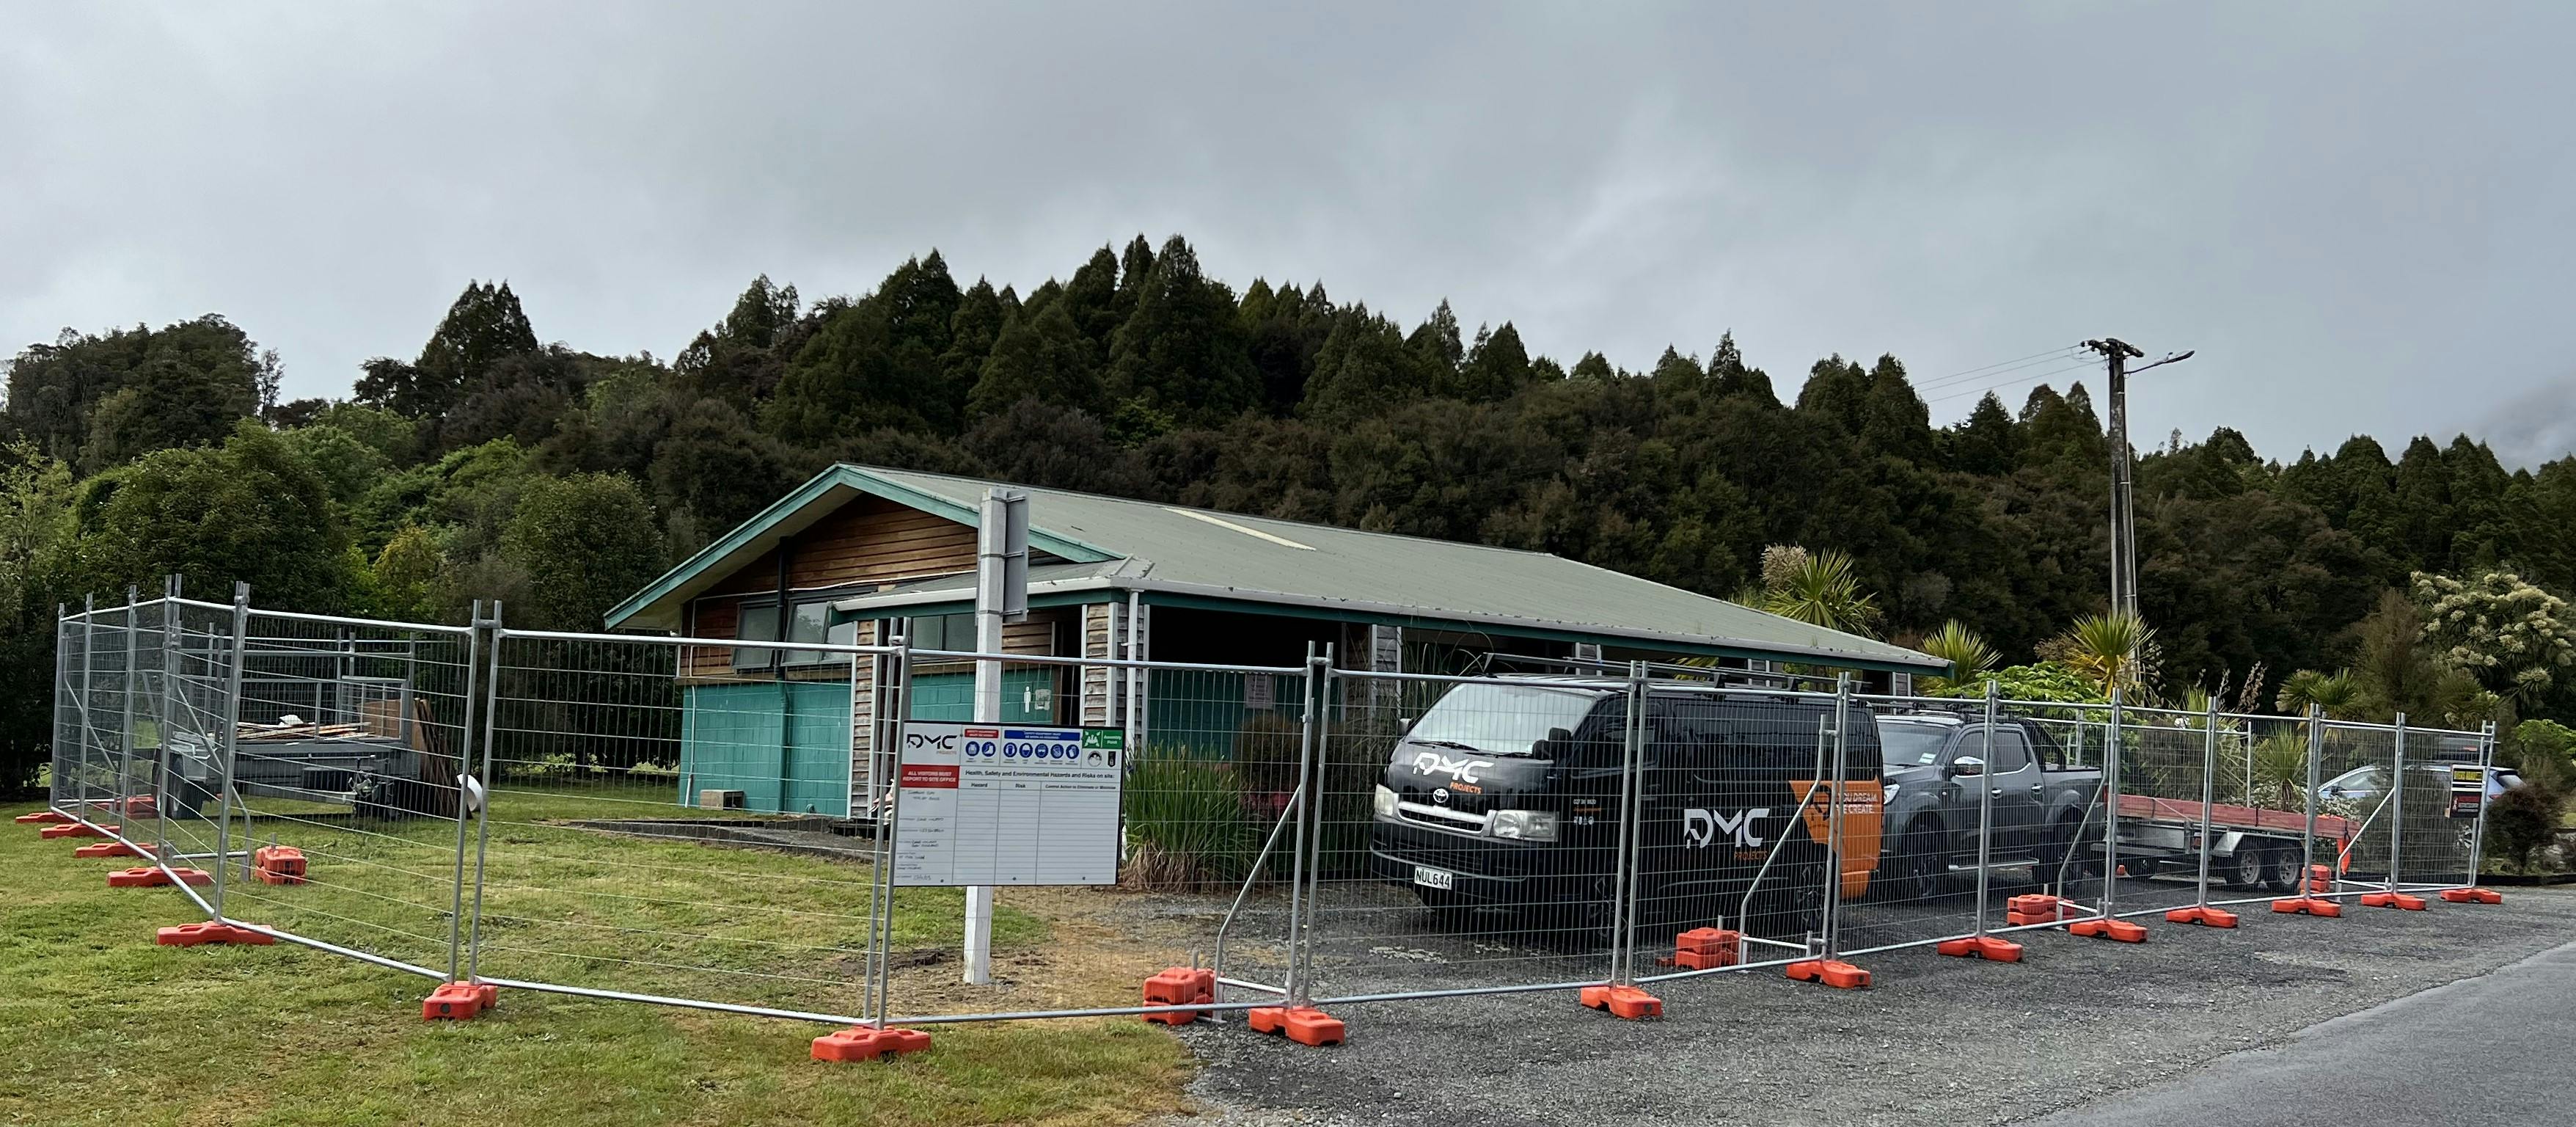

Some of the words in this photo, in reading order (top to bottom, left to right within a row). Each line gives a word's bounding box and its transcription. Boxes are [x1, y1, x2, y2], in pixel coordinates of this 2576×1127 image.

[906, 734, 957, 749] DMC
[1413, 752, 1495, 784] DMC
[1449, 781, 1482, 794] PROJECTS
[1683, 808, 1770, 849] DMC
[1416, 870, 1450, 889] NUL644
